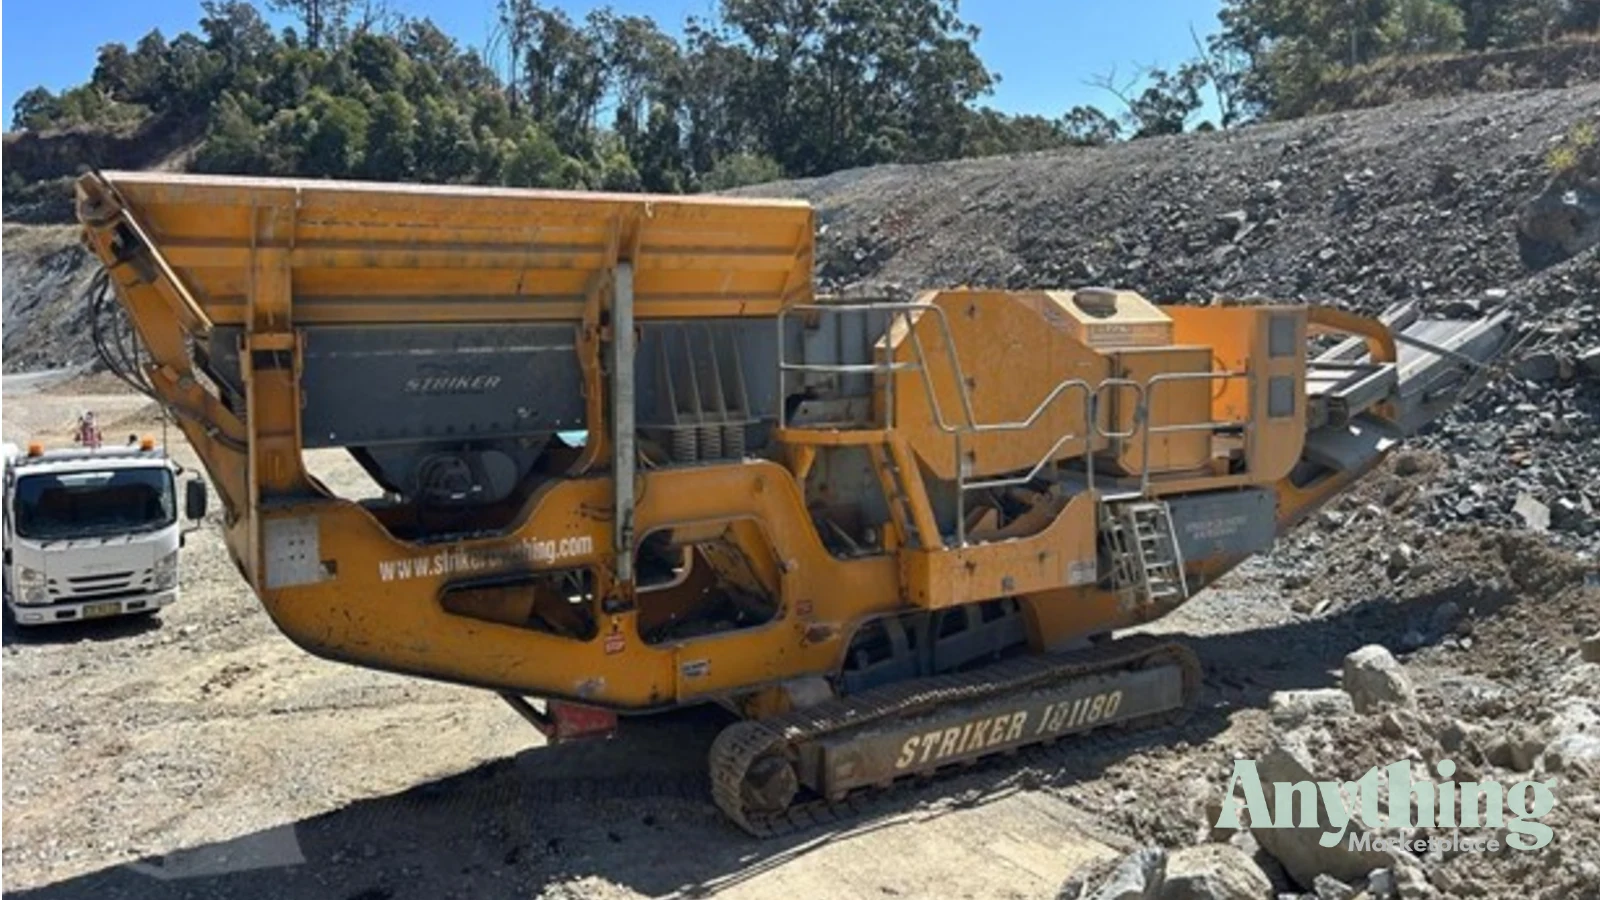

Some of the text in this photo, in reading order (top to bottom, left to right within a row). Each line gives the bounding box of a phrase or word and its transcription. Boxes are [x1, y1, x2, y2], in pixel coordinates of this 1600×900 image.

[404, 376, 501, 392] STRIKER
[378, 537, 592, 581] www.strikerching.com
[895, 711, 1028, 768] STRIKER
